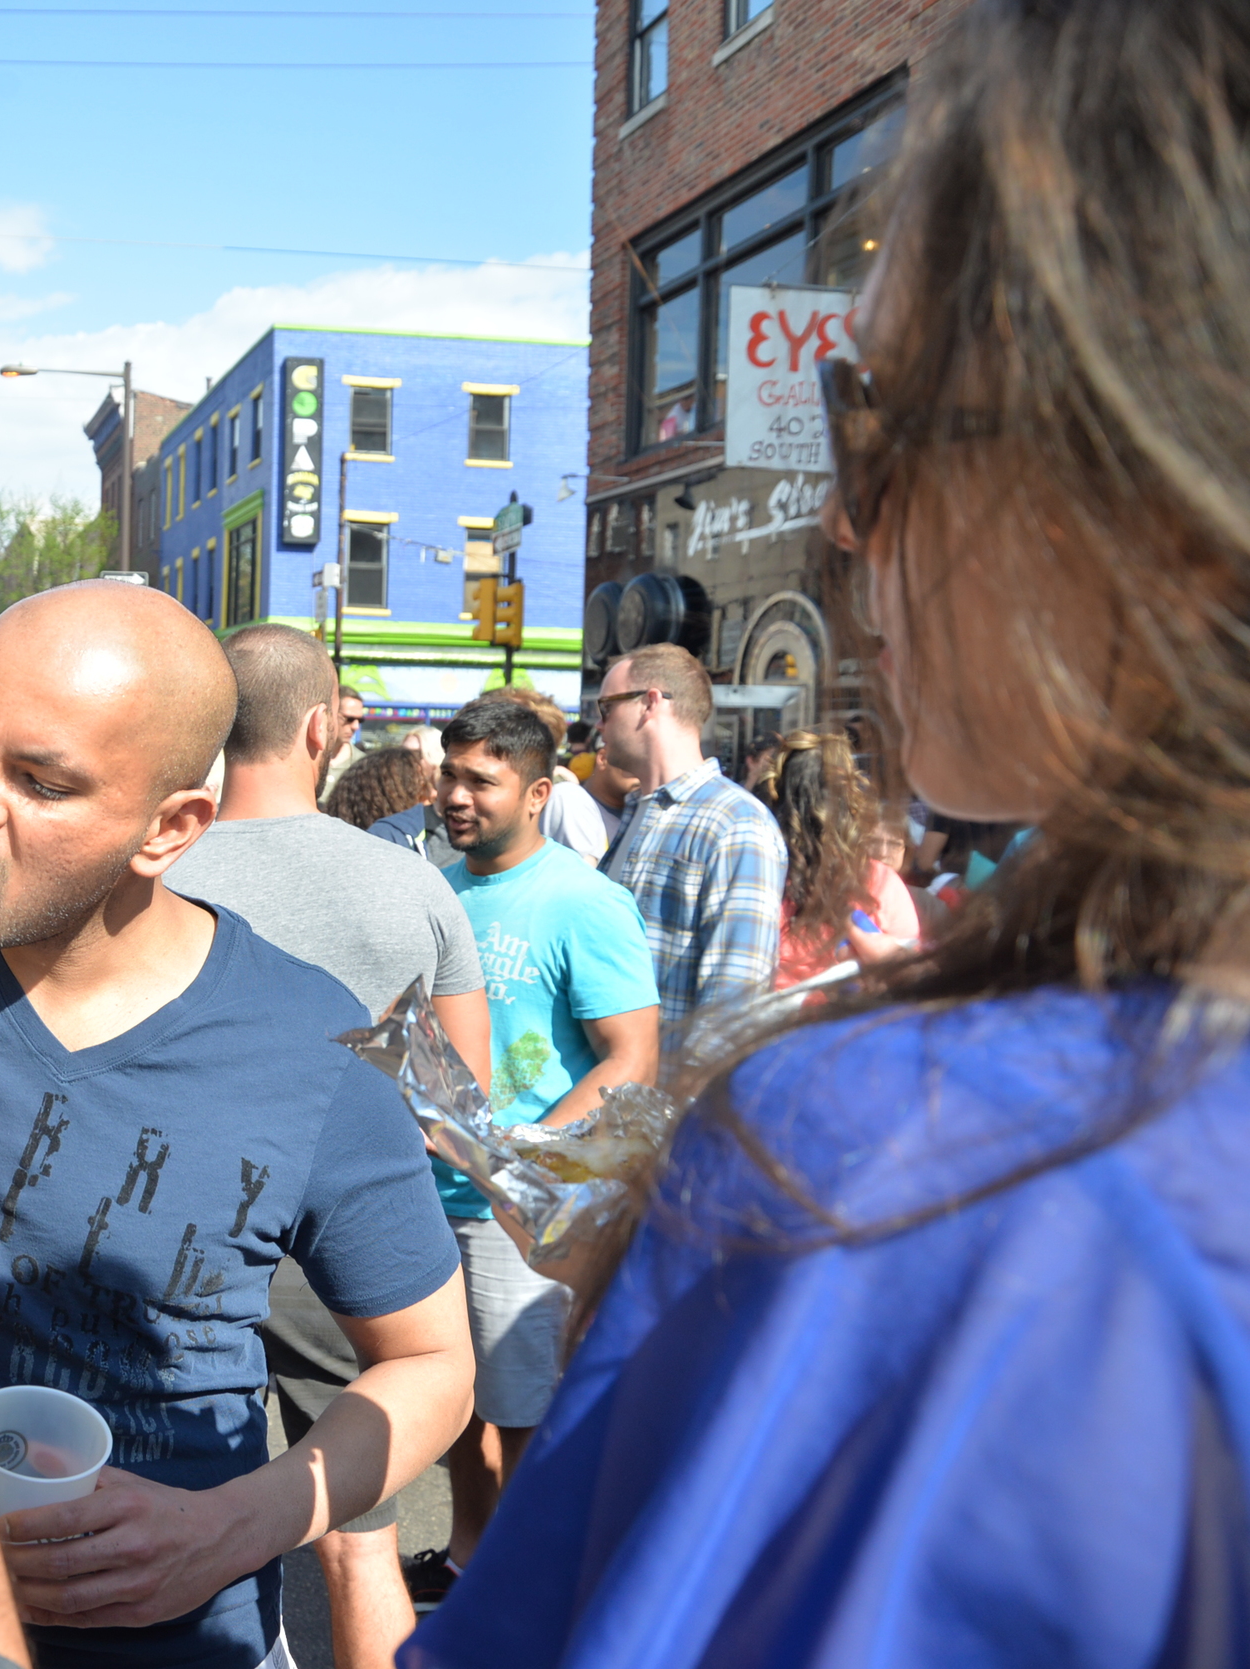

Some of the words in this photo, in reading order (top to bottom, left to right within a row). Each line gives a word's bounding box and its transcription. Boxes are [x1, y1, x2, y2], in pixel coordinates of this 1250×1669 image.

[747, 440, 822, 465] SOUTH
[478, 951, 541, 984] agle
[108, 1428, 177, 1465] TANT
